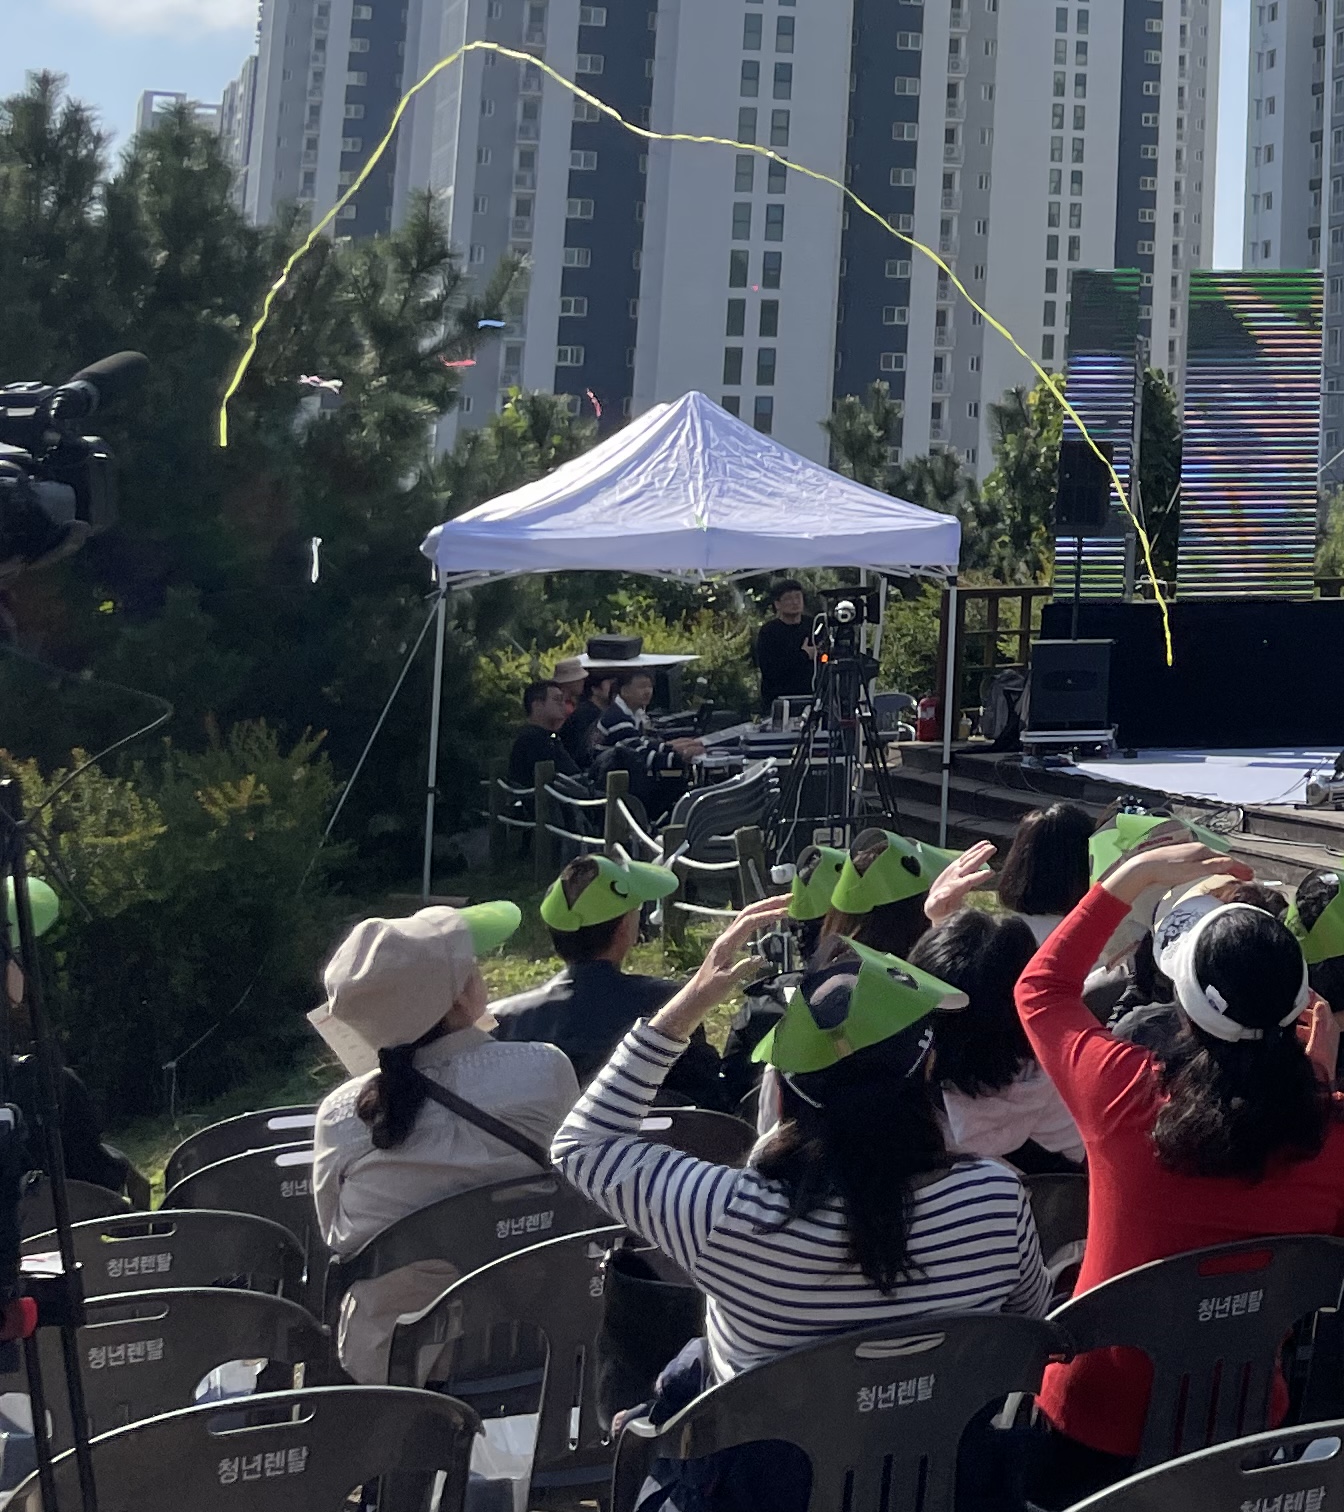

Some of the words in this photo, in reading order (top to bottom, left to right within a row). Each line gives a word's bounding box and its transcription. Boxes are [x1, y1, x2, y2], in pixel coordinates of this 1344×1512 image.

[280, 1179, 315, 1198] 청년
[495, 1210, 556, 1240] 청년렌탈
[106, 1252, 174, 1279] 청년렌탈
[1197, 1288, 1266, 1323] 청년렌탈
[87, 1337, 165, 1370] 청년렌탈
[856, 1373, 937, 1413] 청년렌탈
[217, 1445, 311, 1486] 청년렌탈
